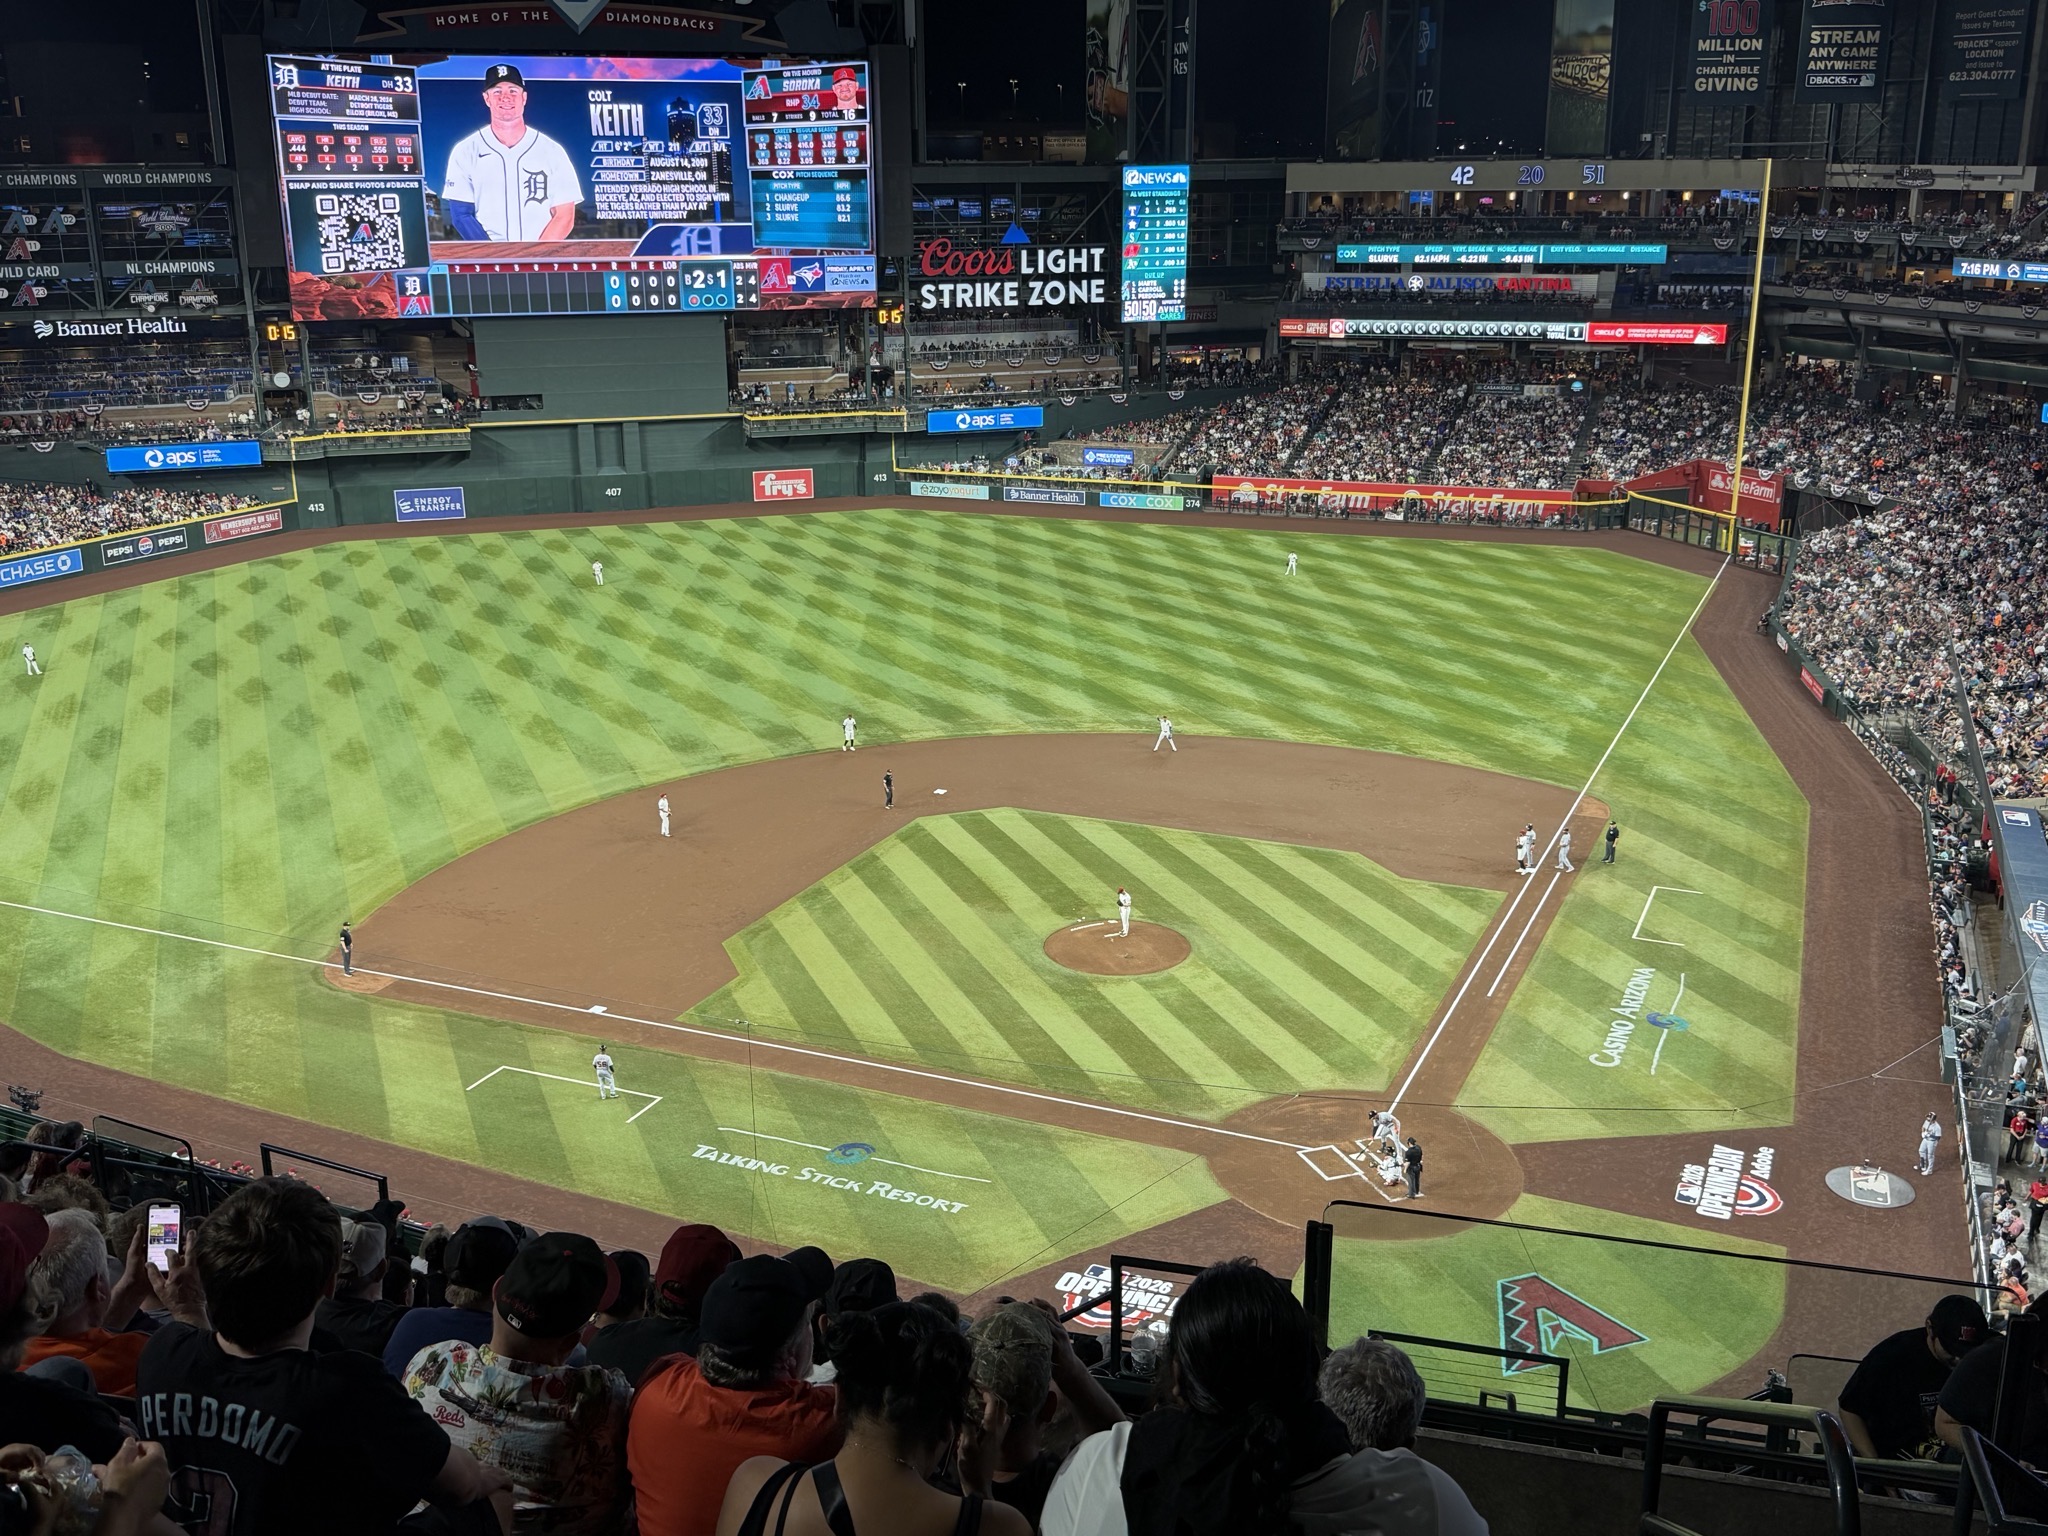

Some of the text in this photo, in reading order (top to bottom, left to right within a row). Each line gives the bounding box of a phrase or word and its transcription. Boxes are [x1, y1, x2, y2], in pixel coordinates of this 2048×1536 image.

[1699, 0, 1760, 36] $100
[1956, 8, 2024, 20] Report Guest Conduct
[436, 11, 716, 31] HOME OF THE DIAMONDBACKS
[1962, 20, 2015, 30] Issues Texting
[1810, 31, 1880, 44] STREAM
[1698, 38, 1763, 52] MILLION
[1722, 54, 1735, 64] IN
[1808, 48, 1878, 58] ANY GAME
[1966, 50, 2004, 58] LOCATION
[343, 65, 362, 74] PLATE
[1696, 66, 1760, 75] CHARITABLE
[1807, 60, 1877, 70] ANYWHERE
[1810, 76, 1858, 85] DBACKS.TV
[1949, 70, 2016, 82] 623.304.0777
[326, 75, 413, 92] KEITH DH 33
[782, 78, 820, 92] SOROKA
[1694, 77, 1758, 92] GIVING
[588, 91, 612, 102] COLT
[786, 94, 820, 110] RHP 34
[350, 102, 374, 110] DETROIT
[590, 104, 723, 136] KEITH 33
[772, 112, 778, 122] 7
[810, 110, 816, 121] 9
[842, 109, 856, 120] 16
[708, 127, 719, 136] DH
[668, 142, 680, 152] 211
[602, 158, 708, 168] BIRTHDAY AUGUST 2001
[7, 174, 77, 186] CHAMPIONS
[102, 172, 212, 184] WORLD CHAMPIONS
[651, 172, 694, 182] ZANESVILLE,
[772, 170, 794, 180] COX
[1451, 166, 1604, 185] 42 20 51
[594, 184, 710, 193] ATTENDED VERRADO HIGH SCHOOL
[596, 193, 730, 203] BUCKEYE, AND ELECTED WITH
[774, 194, 810, 202] CHANGEUP
[596, 202, 698, 210] THE TIGERS RATHER THAN PLAY
[774, 204, 799, 212] SLURVE
[138, 211, 158, 224] World
[596, 210, 688, 220] ARIZONA STATE UNIVERSITY
[775, 214, 799, 222] SLURVE
[920, 238, 1105, 276] Coors LIGHT
[1338, 250, 1358, 258] COX
[27, 266, 58, 277] CARD
[126, 261, 216, 274] NL CHAMPIONS
[612, 261, 677, 270] R H E LOB
[1960, 262, 2000, 276] 7:16 PM
[610, 275, 756, 288] 0 0 0 0 2 4
[685, 270, 726, 289] B 2 S 1
[1326, 277, 1572, 290] ESTRELLA JALISCO CANTINA
[130, 294, 168, 304] CHAMPIONS
[920, 278, 1105, 310] STRIKE ZONE
[612, 293, 758, 308] 0 0 0 0 2 4
[879, 310, 902, 324] 0:15
[57, 320, 123, 337] Banner
[269, 324, 296, 340] 0:15
[1546, 332, 1566, 340] TOTAL
[972, 414, 994, 428] aps
[166, 452, 196, 466] aps
[874, 473, 888, 482] 413
[760, 473, 806, 497] fry's
[605, 487, 622, 497] 407
[1020, 492, 1080, 502] Banner Health
[414, 496, 451, 505] ENERGY
[1110, 496, 1173, 508] COX COX
[1186, 500, 1200, 508] 374
[308, 502, 324, 512] 413
[416, 502, 462, 512] TRANSFER
[221, 516, 258, 530] MEMBERSHIPS
[106, 534, 184, 558] PEPSI PEPSI
[0, 560, 56, 582] CHASE
[1610, 968, 1656, 1020] ARIZONA
[1588, 1020, 1636, 1068] CASINO
[1750, 1146, 1774, 1180] Adobe
[692, 1144, 969, 1214] TALKING STICK RESORT
[1696, 1166, 1740, 1220] OPENING
[1128, 1275, 1174, 1294] 2026
[434, 1405, 465, 1428] Reds
[141, 1393, 303, 1466] PERDOMO
